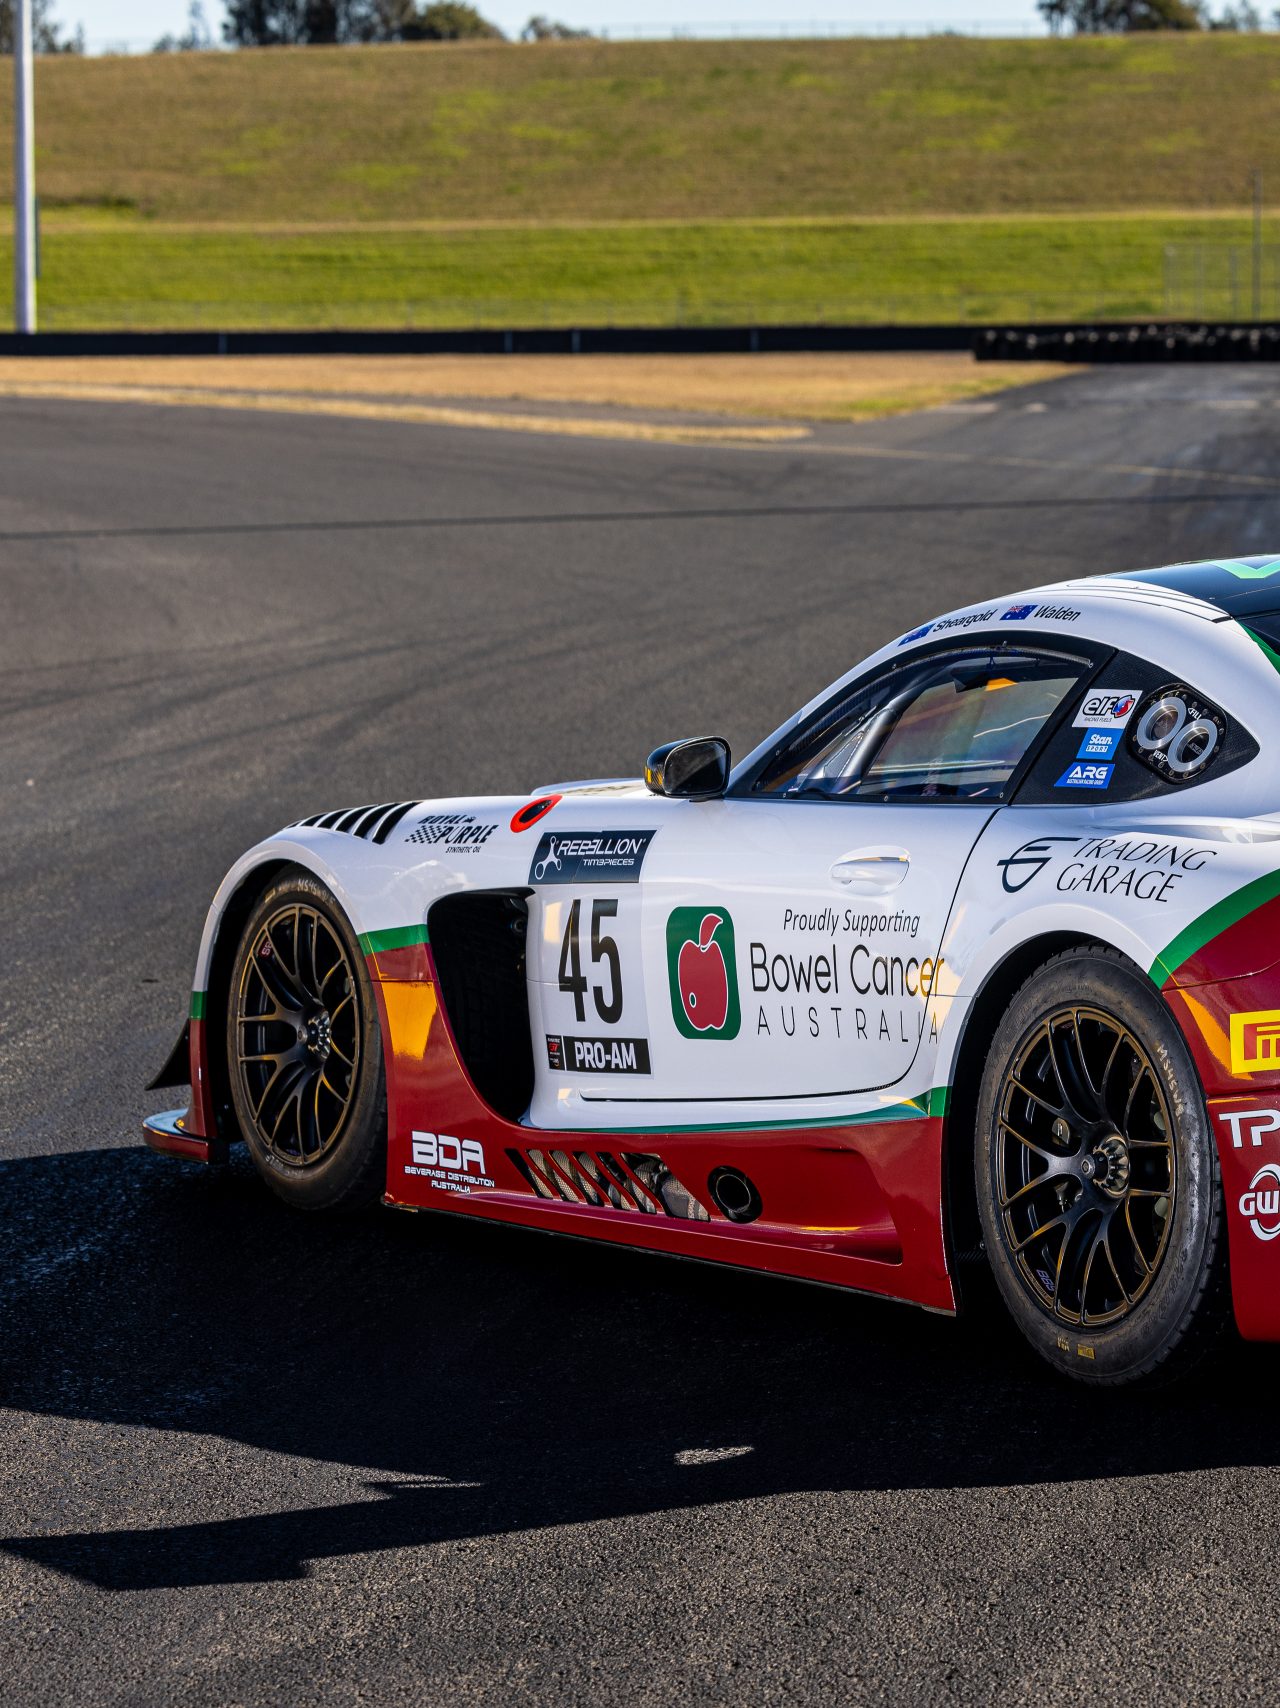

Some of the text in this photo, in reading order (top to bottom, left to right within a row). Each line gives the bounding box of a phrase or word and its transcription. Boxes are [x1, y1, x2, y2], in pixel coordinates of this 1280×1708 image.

[933, 605, 1081, 633] Sheargold Walden
[1069, 766, 1108, 779] ARG
[418, 815, 467, 825] ROYAL
[433, 825, 499, 844] PURPLE
[557, 839, 642, 856] REBELLION
[1073, 838, 1217, 871] TRADING
[1056, 863, 1183, 902] GARAGE
[784, 908, 920, 938] Proudly Supporting
[558, 899, 624, 1024] 45
[750, 942, 944, 998] Bowel Cancer
[757, 1004, 938, 1044] AUSTRALIA
[574, 1041, 637, 1070] PRO-AM
[412, 1130, 486, 1175] BDA
[404, 1165, 495, 1188] BEVERAGE DISTRIBUTION
[431, 1180, 471, 1194] AUSTRALIA
